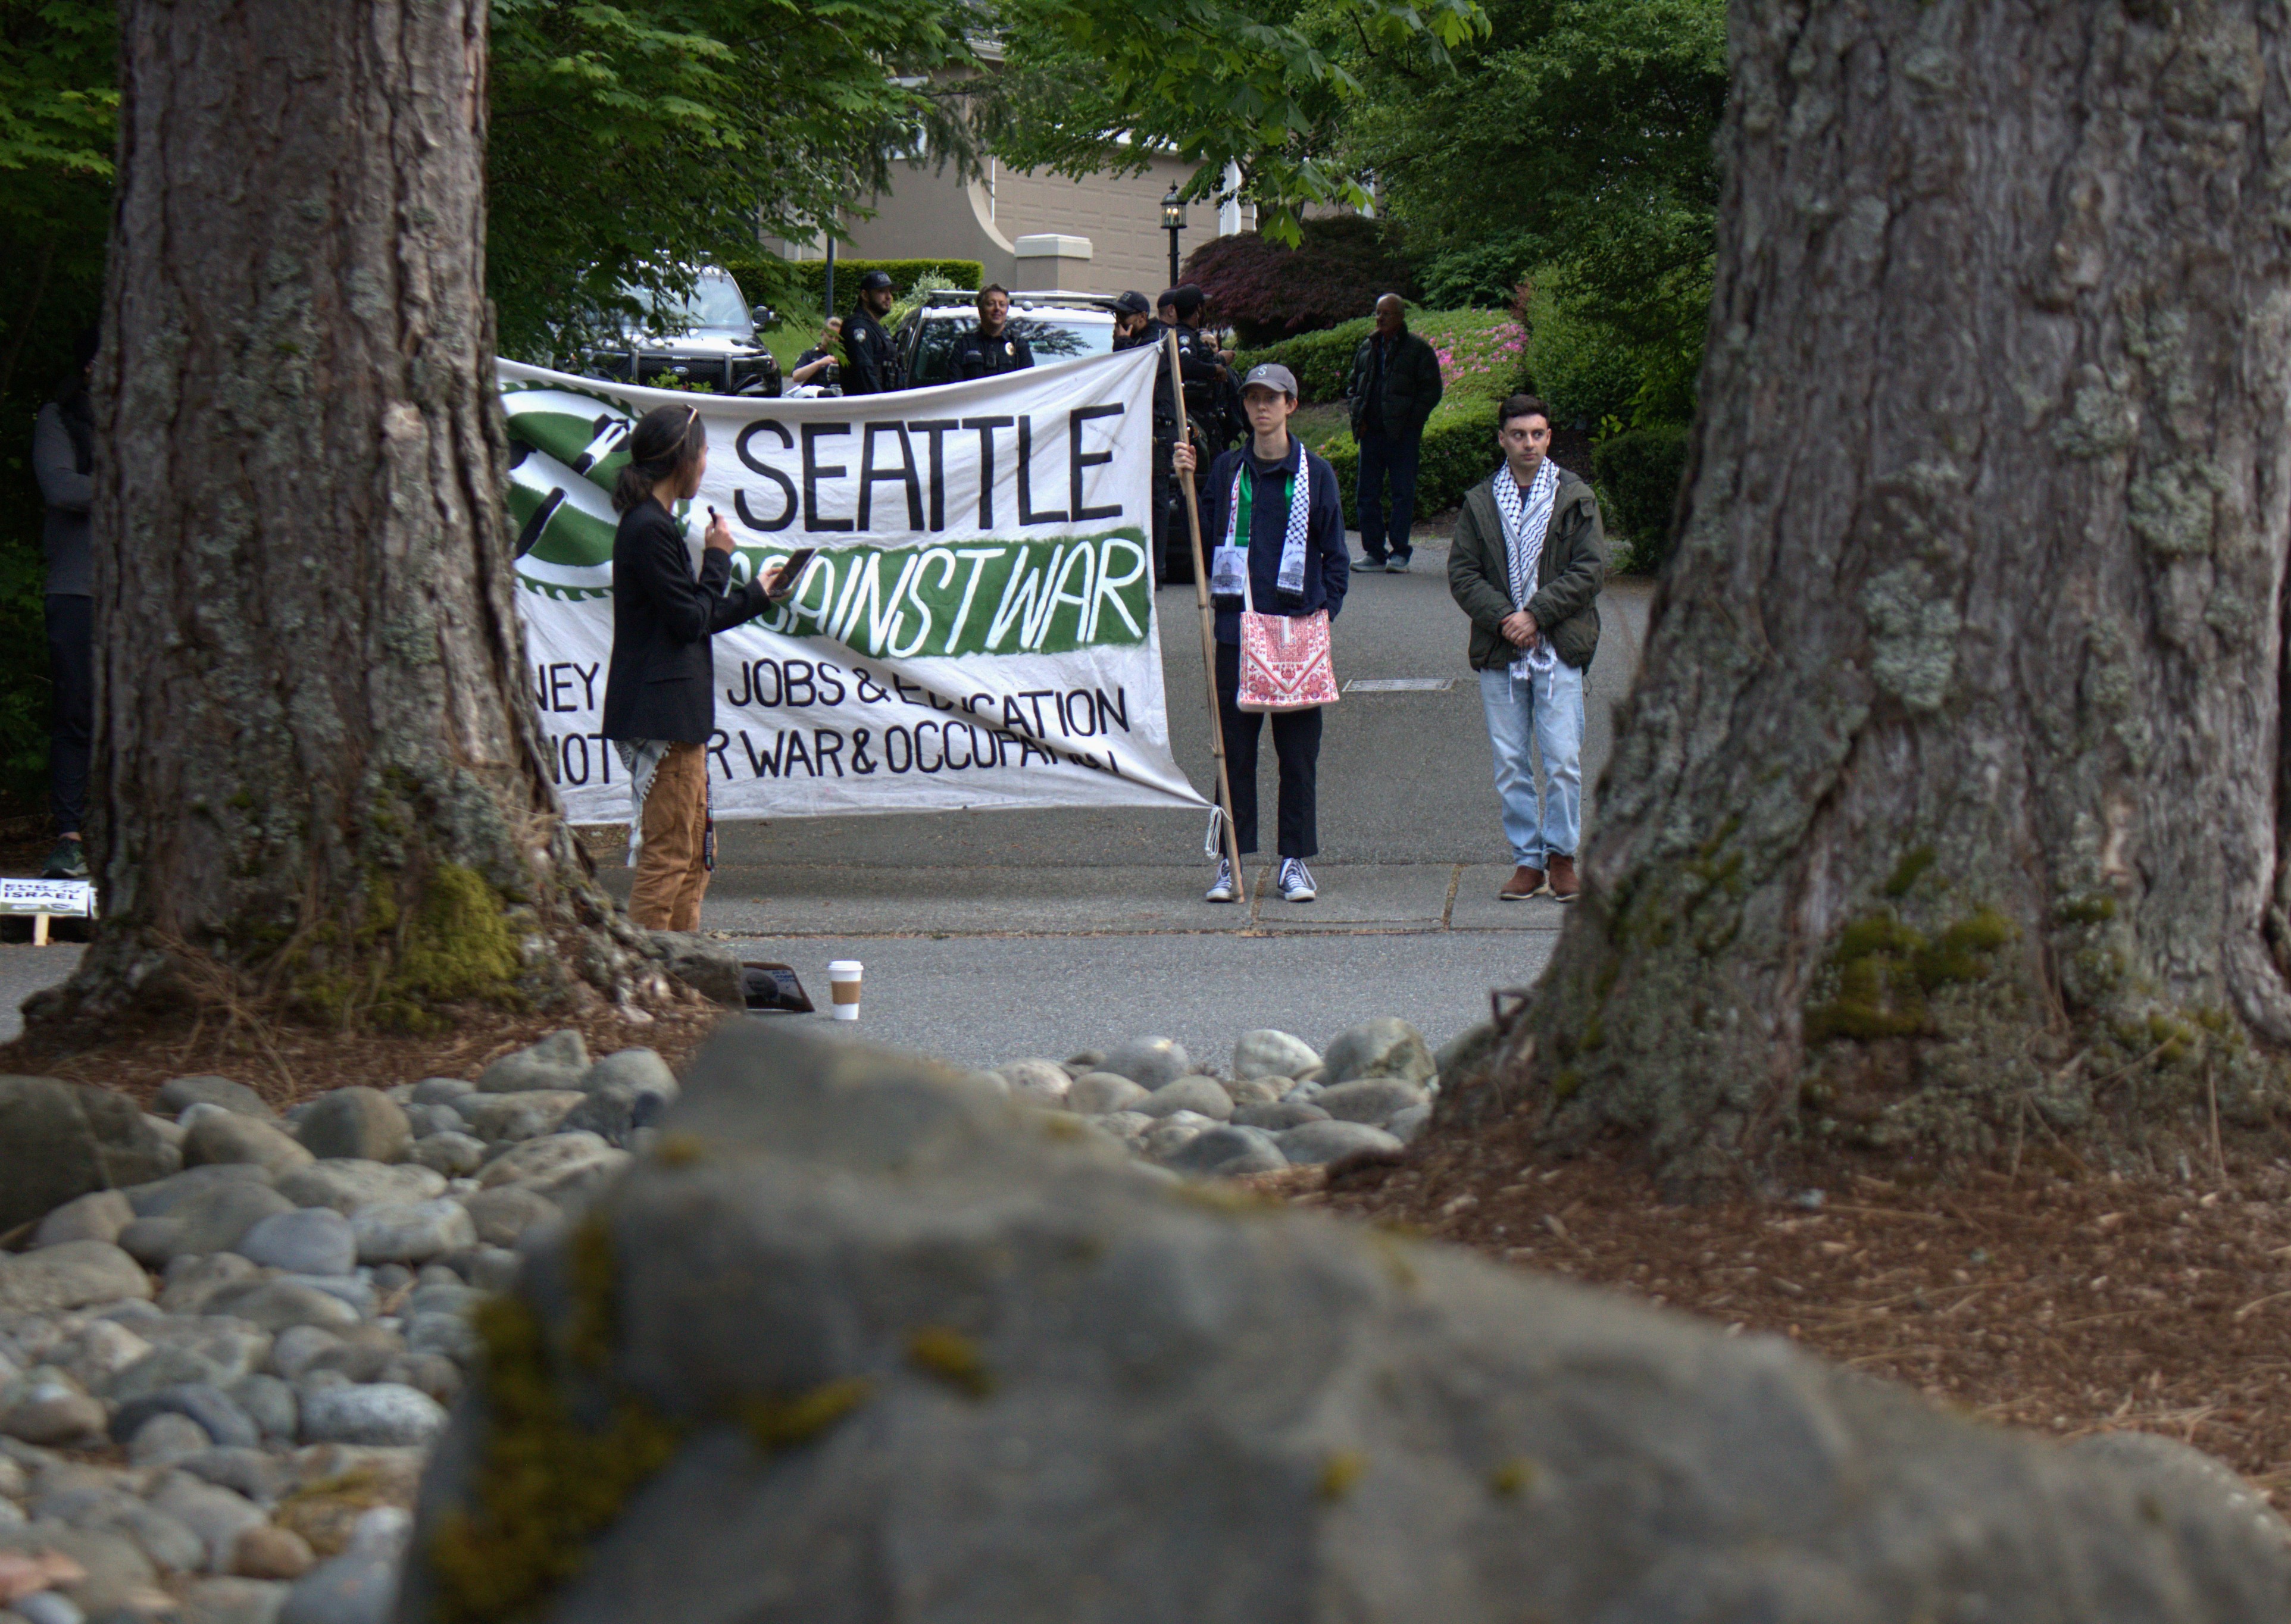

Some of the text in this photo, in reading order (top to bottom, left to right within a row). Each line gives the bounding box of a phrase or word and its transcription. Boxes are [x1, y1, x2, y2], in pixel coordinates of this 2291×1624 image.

[734, 402, 1124, 531] SEATTLE
[985, 538, 1143, 650] WAR
[727, 658, 846, 707] JOBS
[739, 728, 843, 779] WAR
[852, 728, 878, 774] &
